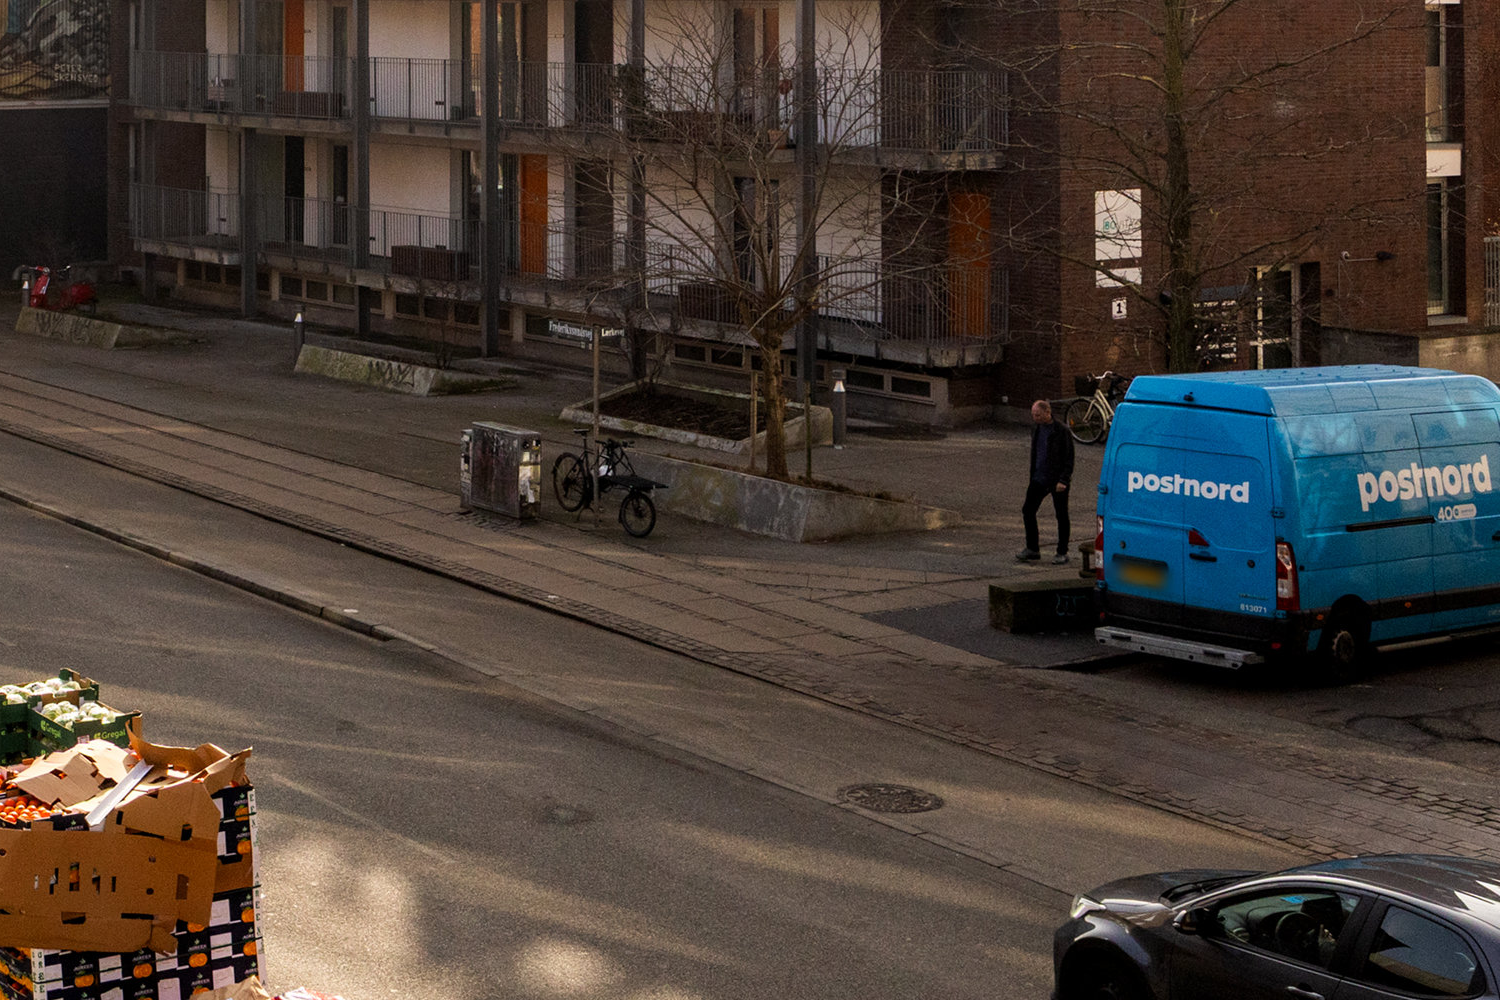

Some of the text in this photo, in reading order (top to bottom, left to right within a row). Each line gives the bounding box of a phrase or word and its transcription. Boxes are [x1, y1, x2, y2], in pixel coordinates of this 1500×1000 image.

[1116, 302, 1123, 314] 1
[1127, 471, 1250, 504] postnord
[1356, 453, 1493, 513] postnord
[1240, 603, 1267, 613] 813071
[101, 728, 126, 740] Gregal
